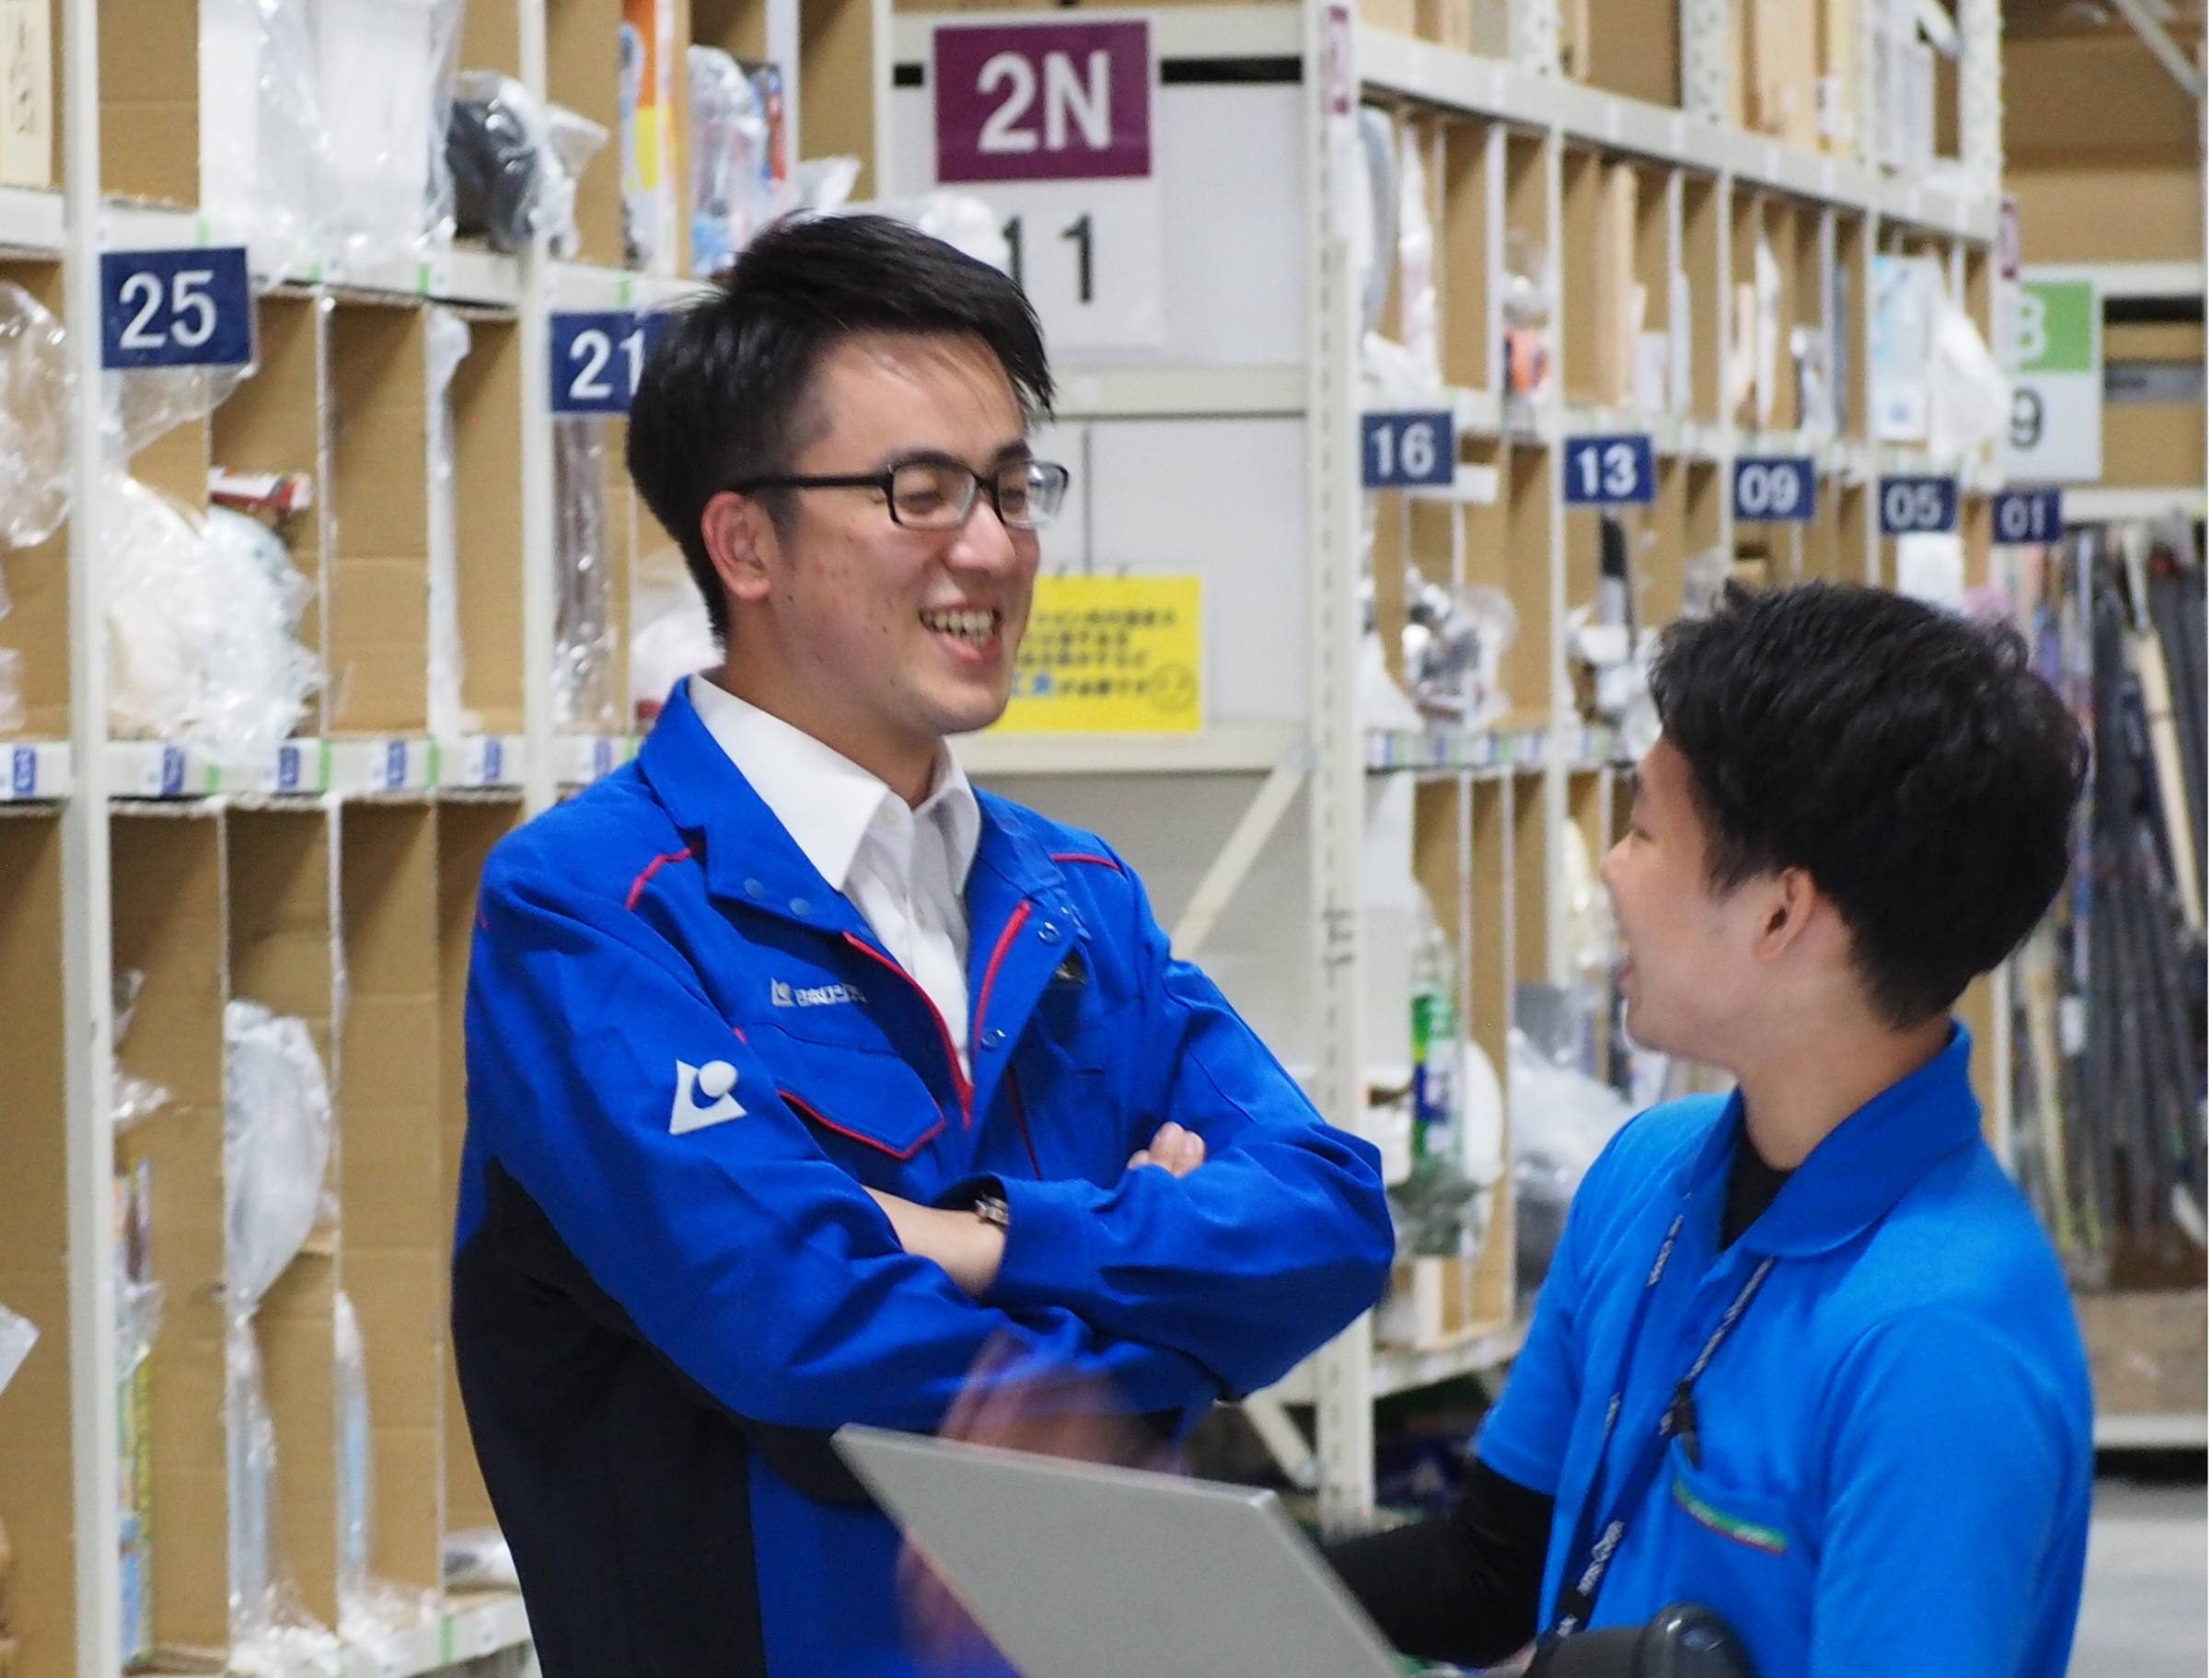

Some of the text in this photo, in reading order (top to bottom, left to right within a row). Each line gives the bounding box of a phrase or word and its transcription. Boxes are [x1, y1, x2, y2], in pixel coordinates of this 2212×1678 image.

[978, 50, 1112, 153] 2N
[1002, 214, 1094, 304] 11
[120, 270, 217, 351] 25
[569, 329, 645, 399] 21
[1374, 422, 1435, 478] 16
[1578, 443, 1638, 496] 13
[1738, 465, 1800, 514] 09
[1885, 484, 1943, 528] 05
[2000, 497, 2044, 537] 01
